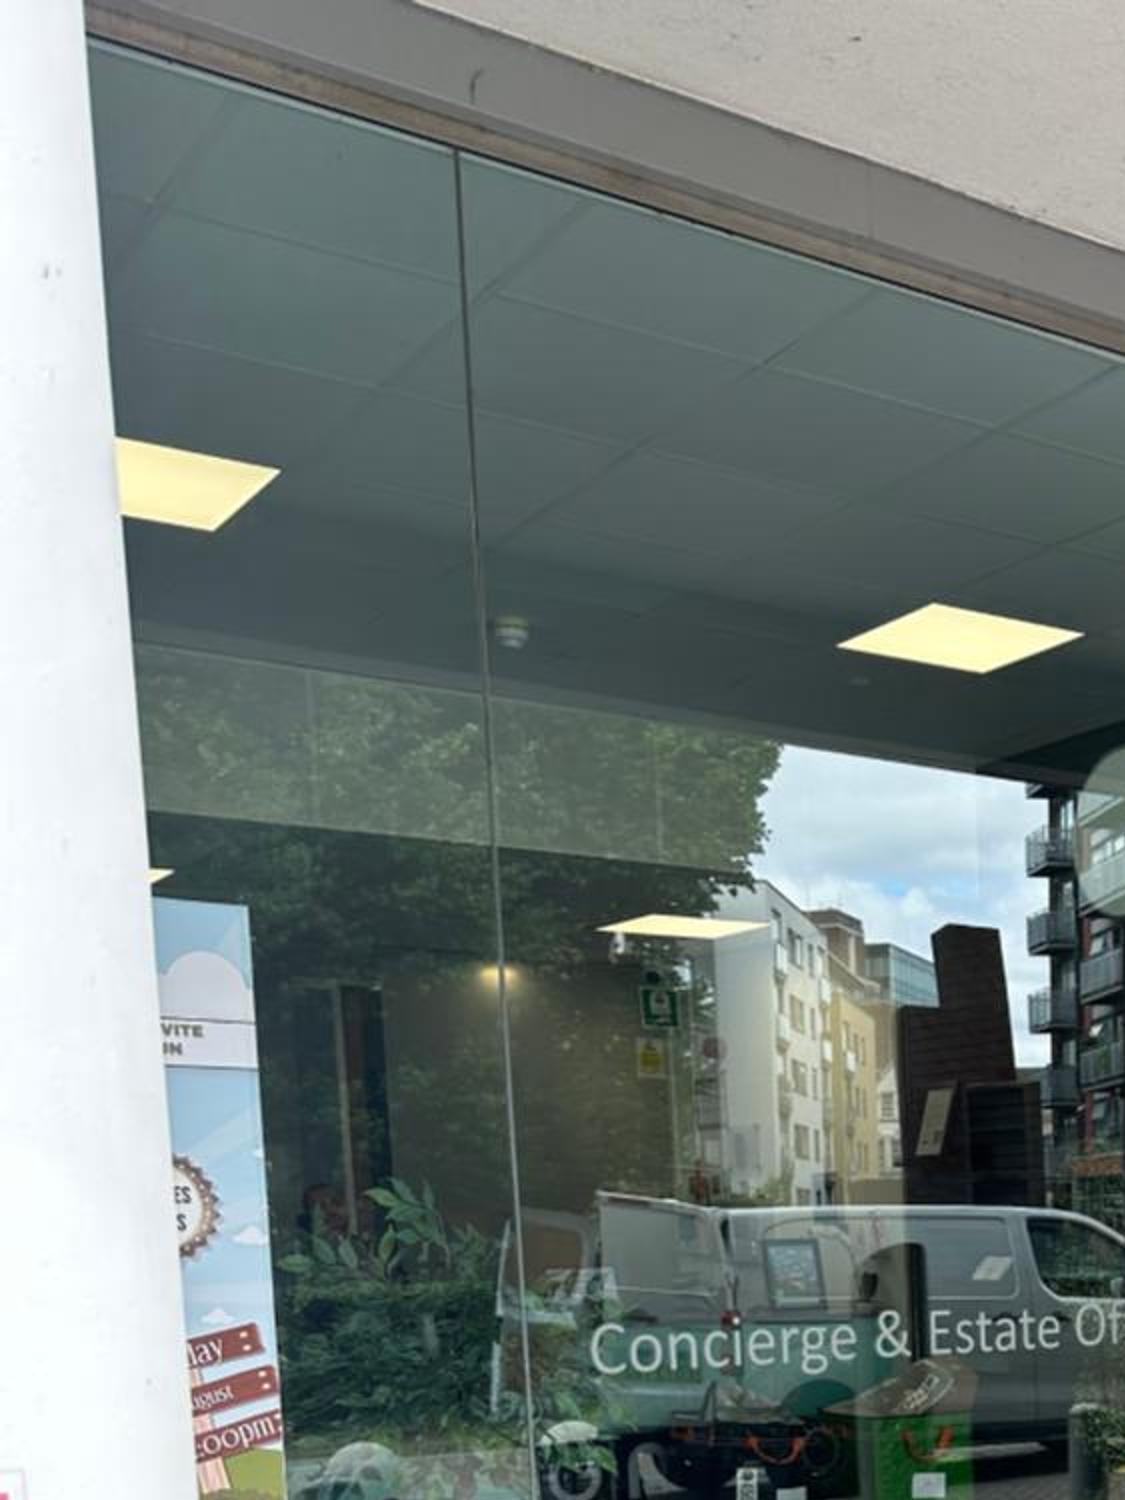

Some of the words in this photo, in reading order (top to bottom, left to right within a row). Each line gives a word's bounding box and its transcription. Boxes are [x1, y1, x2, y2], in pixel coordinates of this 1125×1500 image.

[589, 1322, 858, 1375] Concierge
[875, 1309, 912, 1358] &
[929, 1309, 1061, 1357] Estate
